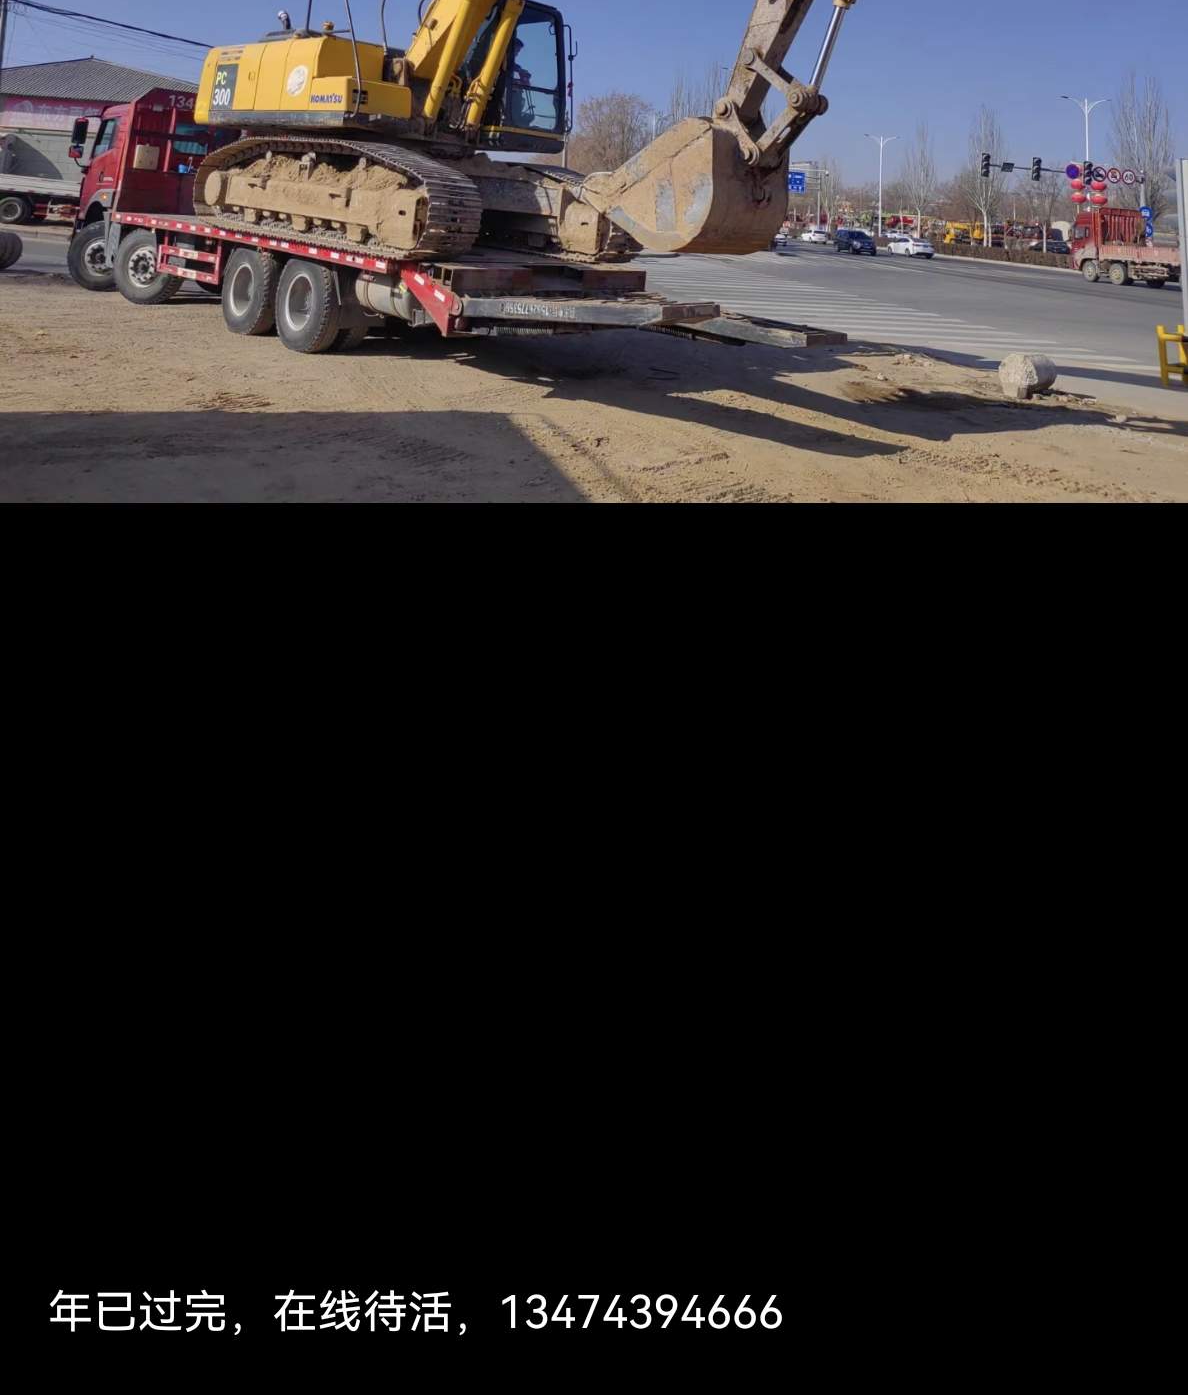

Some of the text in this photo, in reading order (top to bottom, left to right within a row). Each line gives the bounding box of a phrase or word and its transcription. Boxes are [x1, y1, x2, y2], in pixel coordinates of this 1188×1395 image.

[215, 71, 228, 86] PC
[212, 88, 231, 106] 300
[310, 93, 343, 103] KOMATSU
[1125, 172, 1134, 182] 60
